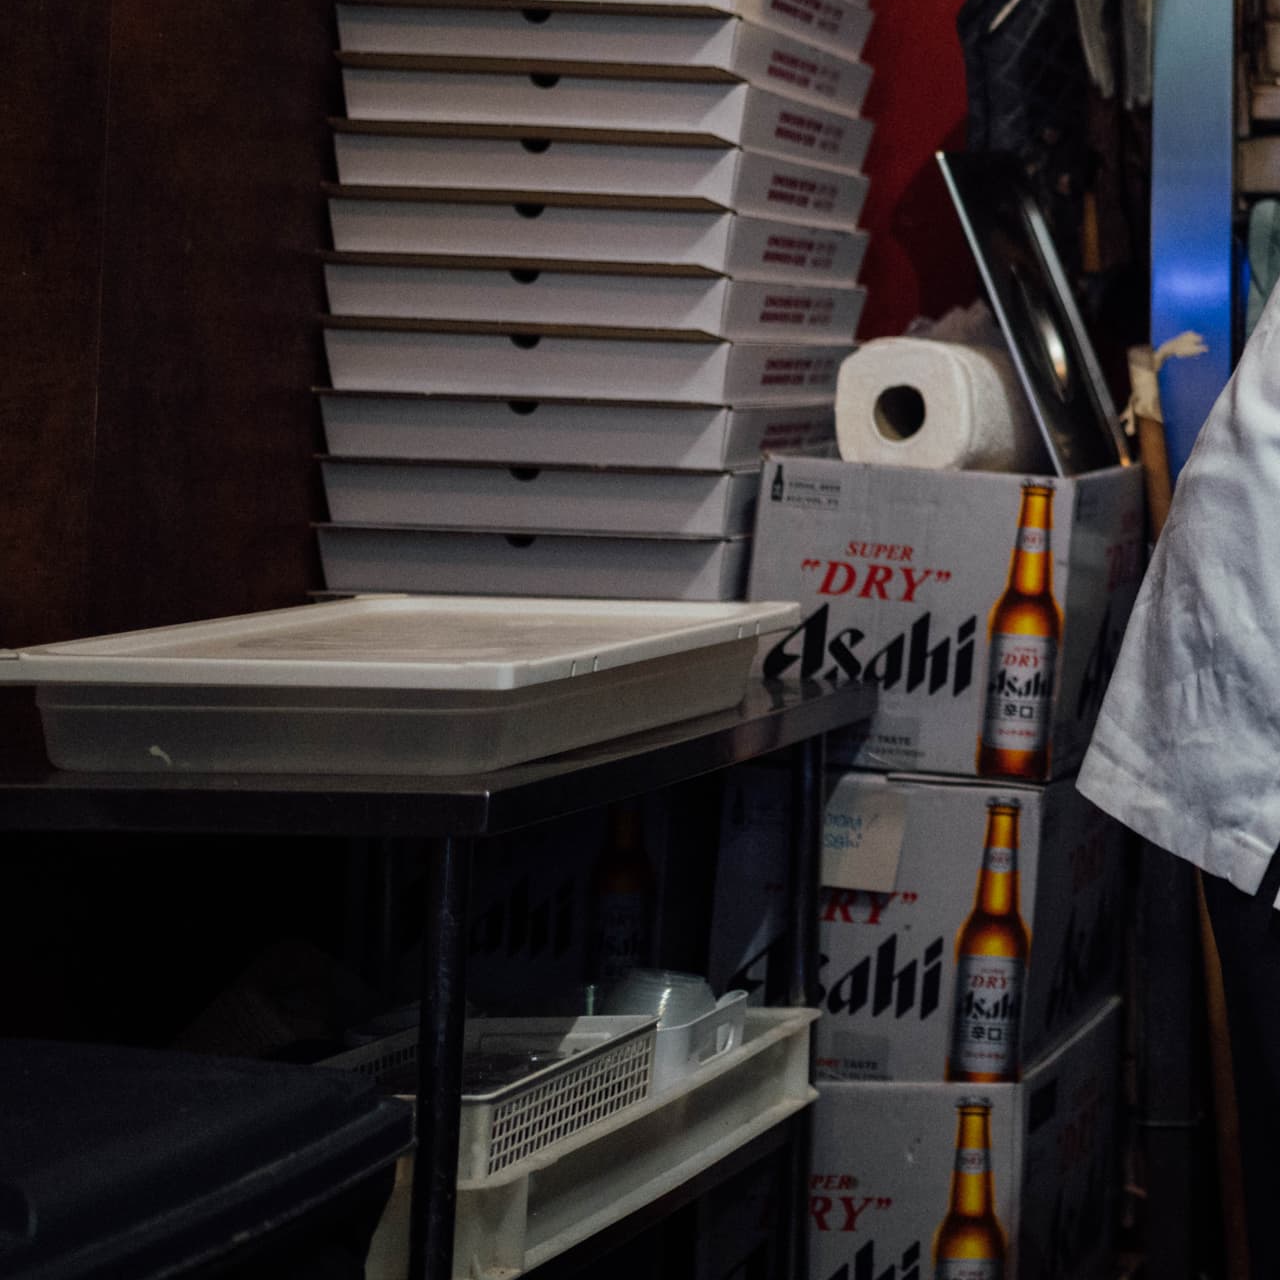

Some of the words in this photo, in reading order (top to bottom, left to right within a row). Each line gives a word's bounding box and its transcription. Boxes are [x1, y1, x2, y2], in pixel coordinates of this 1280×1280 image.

[845, 540, 914, 562] SUPER
[801, 559, 952, 603] "DRY"
[762, 601, 978, 698] Asahi
